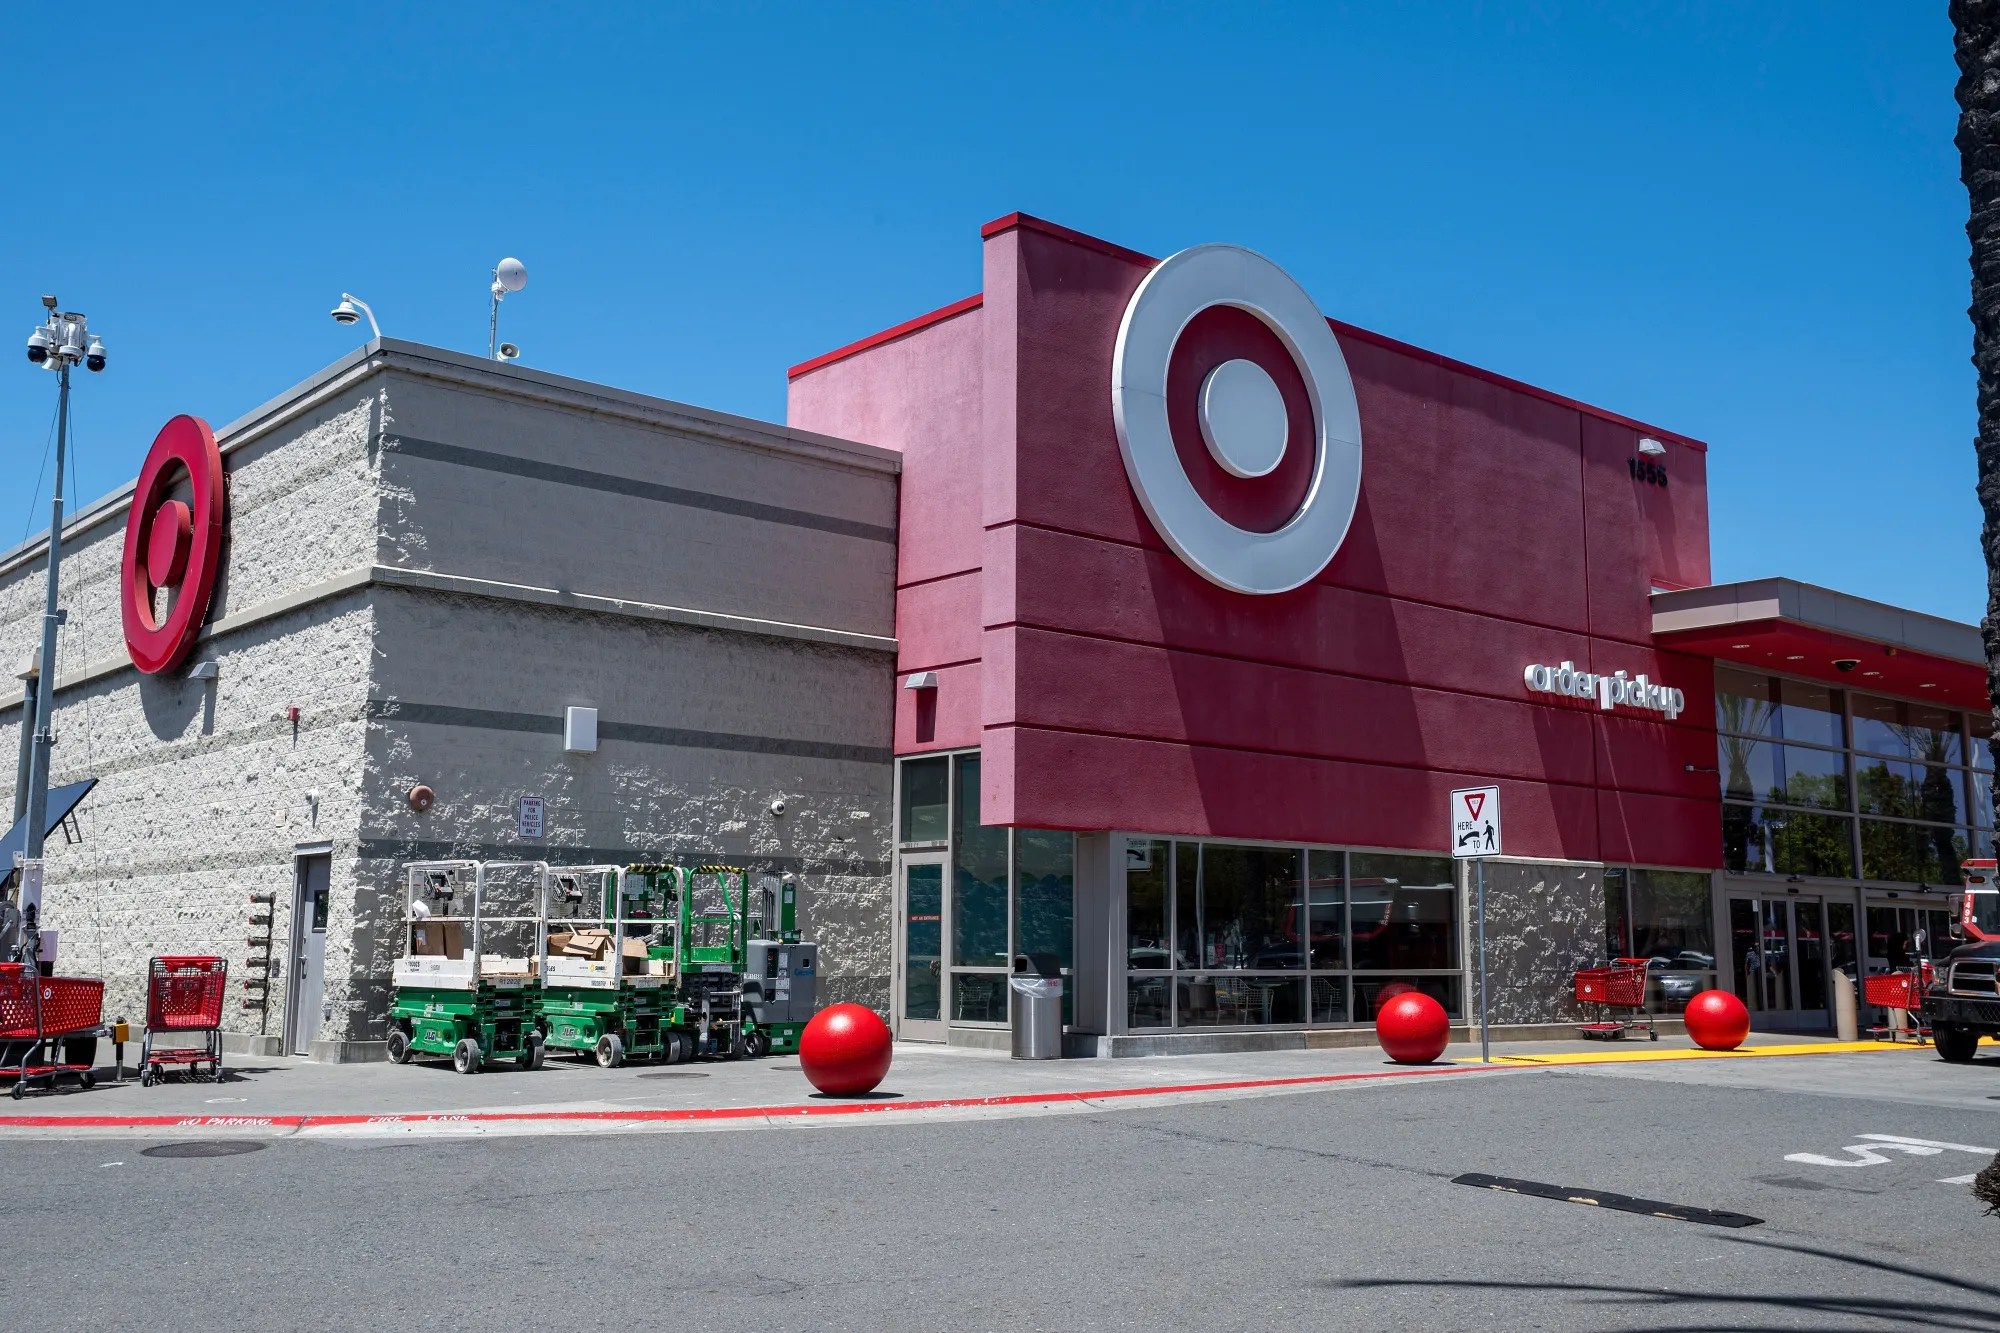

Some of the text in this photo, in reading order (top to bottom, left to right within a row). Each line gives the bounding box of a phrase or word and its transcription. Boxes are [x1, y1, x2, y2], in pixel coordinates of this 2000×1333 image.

[1524, 660, 1684, 720] order pickup
[1457, 821, 1473, 831] HERE
[1473, 840, 1480, 849] TO
[1963, 893, 1972, 924] 1493
[424, 1031, 436, 1040] JLG
[561, 1028, 575, 1037] JLG
[177, 1117, 273, 1126] NO PARKING
